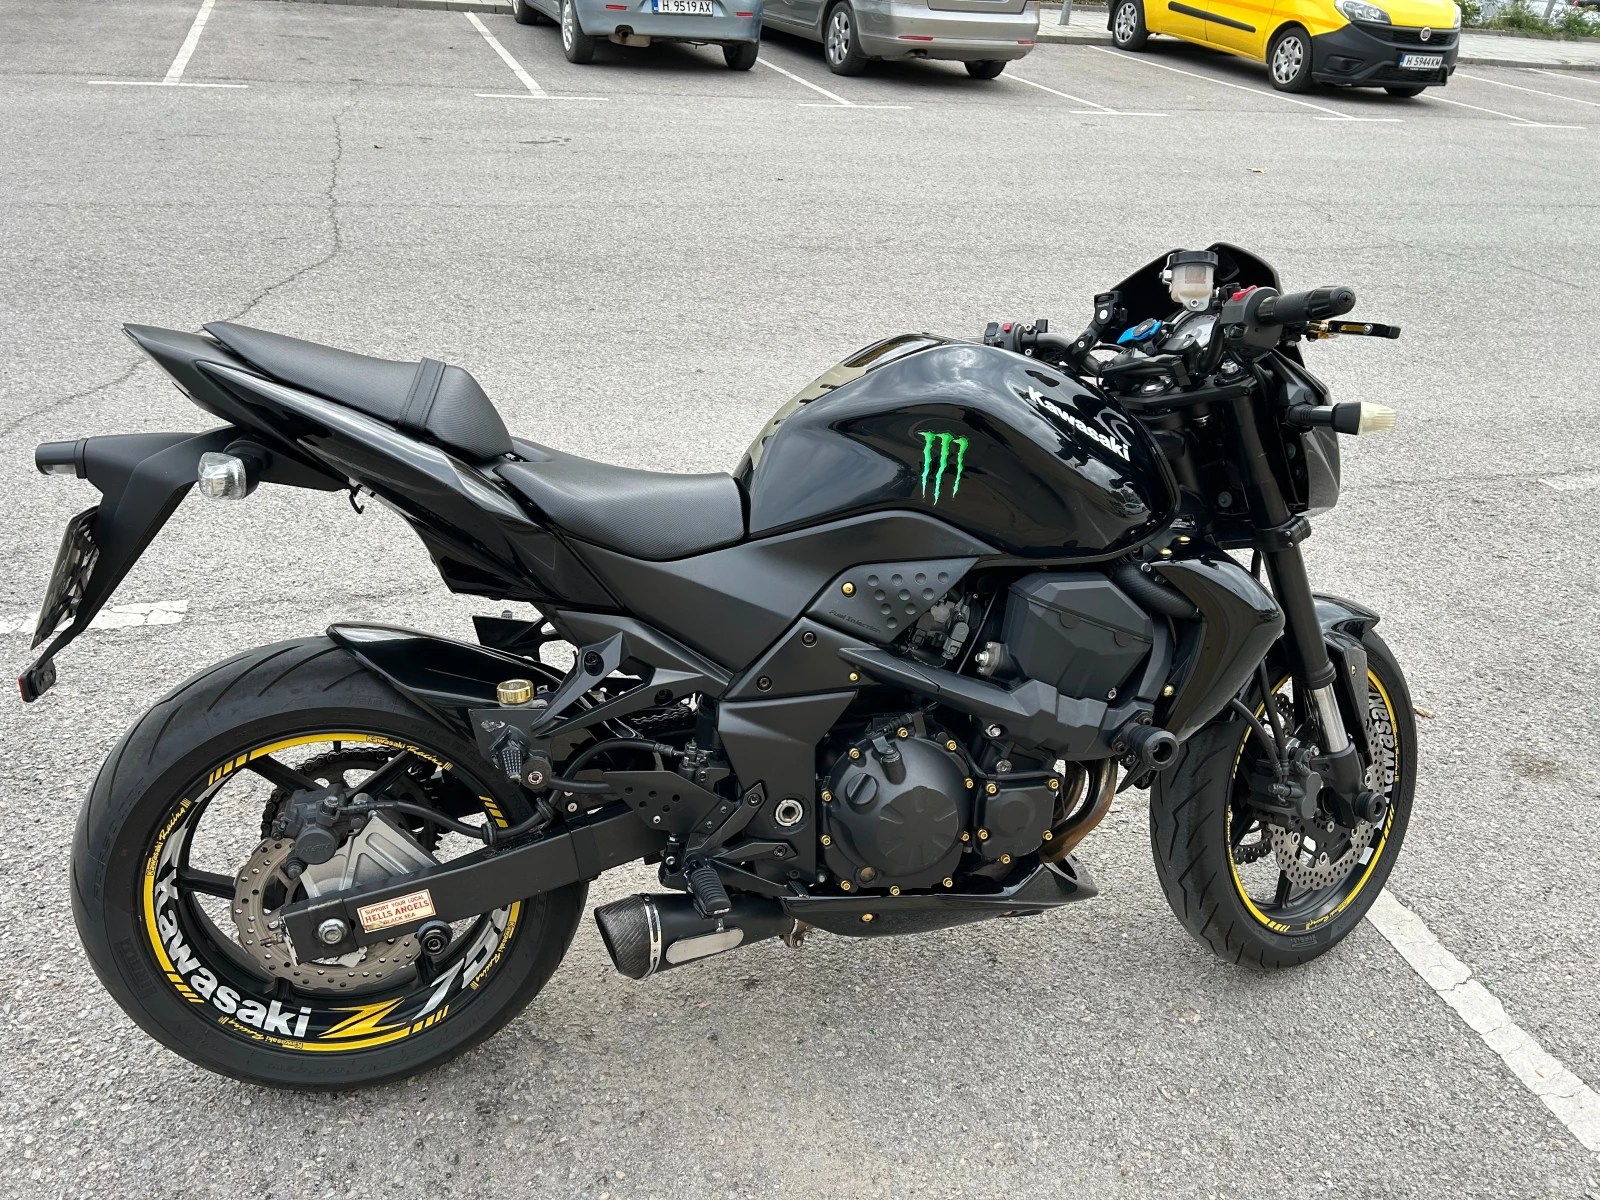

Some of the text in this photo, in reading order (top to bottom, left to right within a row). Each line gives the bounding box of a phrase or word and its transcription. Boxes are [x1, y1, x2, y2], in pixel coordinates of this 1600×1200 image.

[674, 1, 697, 12] 9519
[1028, 385, 1130, 461] Kawasaki
[366, 735, 443, 768] Kawasaki Racing
[146, 807, 185, 876] Kawasaki Racing
[365, 894, 424, 915] SUPPORT YOUR LOCAL
[365, 899, 430, 923] HELLS ANGELS
[404, 911, 416, 919] SEA
[155, 868, 312, 1038] Kawasaki
[265, 1035, 304, 1050] Kawasaki
